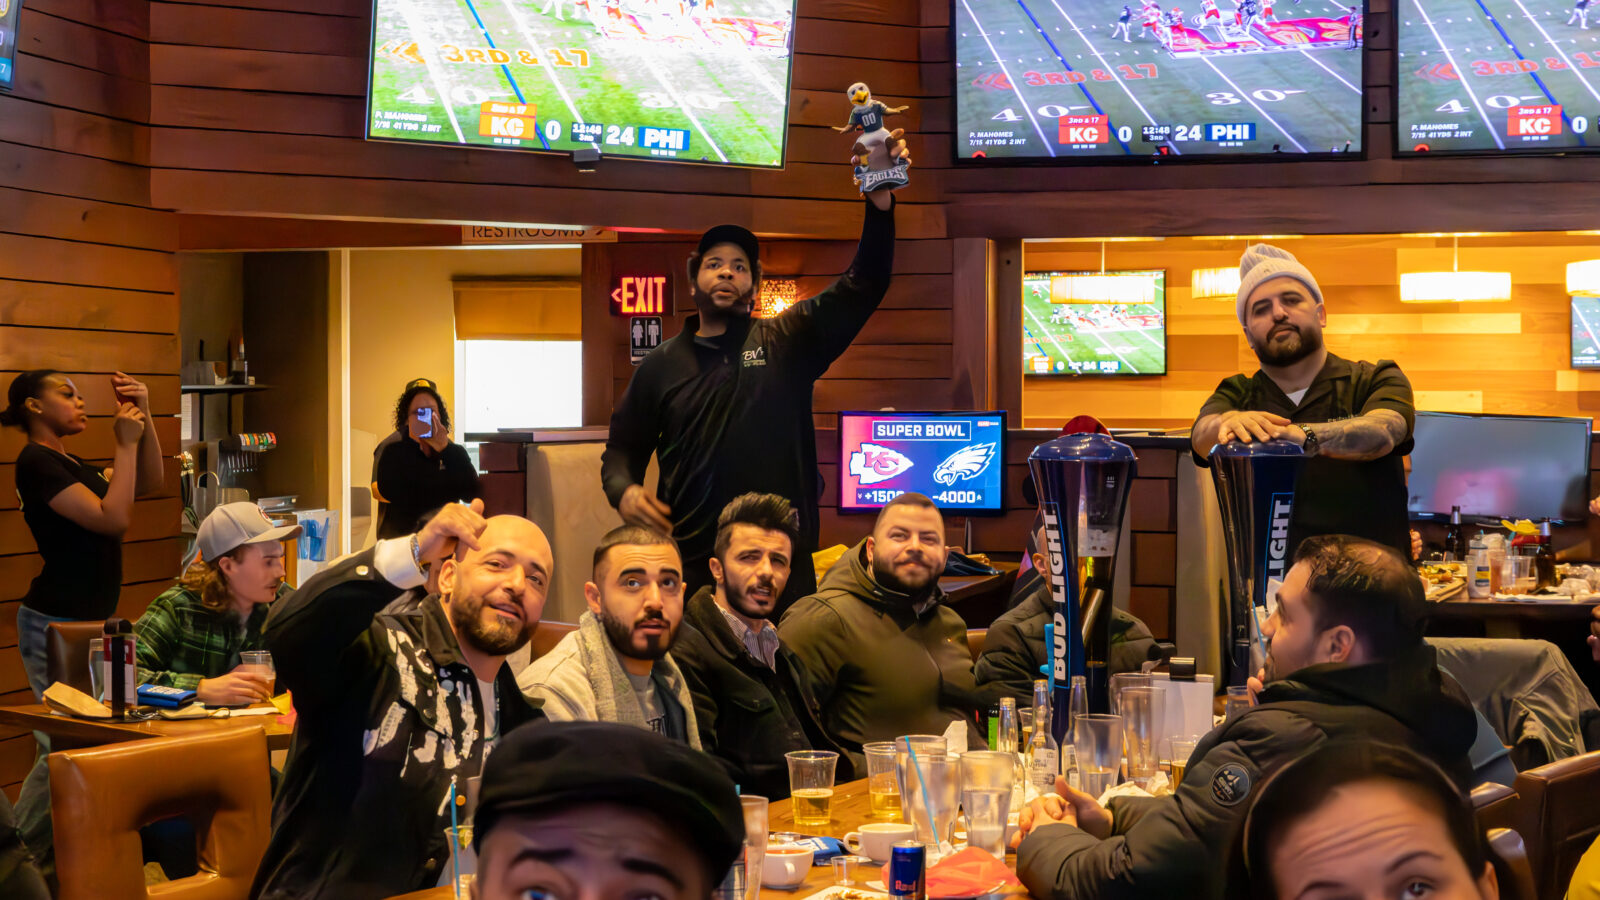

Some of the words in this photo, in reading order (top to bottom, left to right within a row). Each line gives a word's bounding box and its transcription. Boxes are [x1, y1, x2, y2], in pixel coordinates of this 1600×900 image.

[441, 45, 510, 64] 3RD
[518, 49, 538, 65] &
[550, 49, 589, 67] 17
[1470, 59, 1539, 76] 3RD
[1542, 57, 1568, 70] &
[1573, 51, 1600, 69] 1
[1023, 70, 1087, 87] 3RD
[1091, 68, 1112, 82] &
[1118, 63, 1159, 80] 17
[490, 116, 524, 137] KC
[861, 112, 877, 127] 00
[1519, 118, 1551, 134] KC
[1572, 116, 1588, 134] 0
[545, 120, 561, 140] 0
[605, 124, 635, 146] 24
[644, 128, 684, 149] PHI
[1069, 126, 1099, 143] KC
[1118, 125, 1133, 142] 0
[1143, 126, 1170, 135] 12:48
[1175, 125, 1202, 142] 24
[1211, 124, 1250, 140] PHI
[1460, 130, 1473, 138] INT
[864, 165, 906, 188] EAGLES
[622, 277, 666, 312] EXIT
[877, 424, 922, 437] SUPER
[925, 424, 966, 437] BOWL
[864, 451, 900, 475] KC
[932, 491, 976, 503] -4000
[1268, 500, 1291, 583] LIGHT
[1043, 508, 1066, 603] LIGHT
[1054, 612, 1067, 681] BUD
